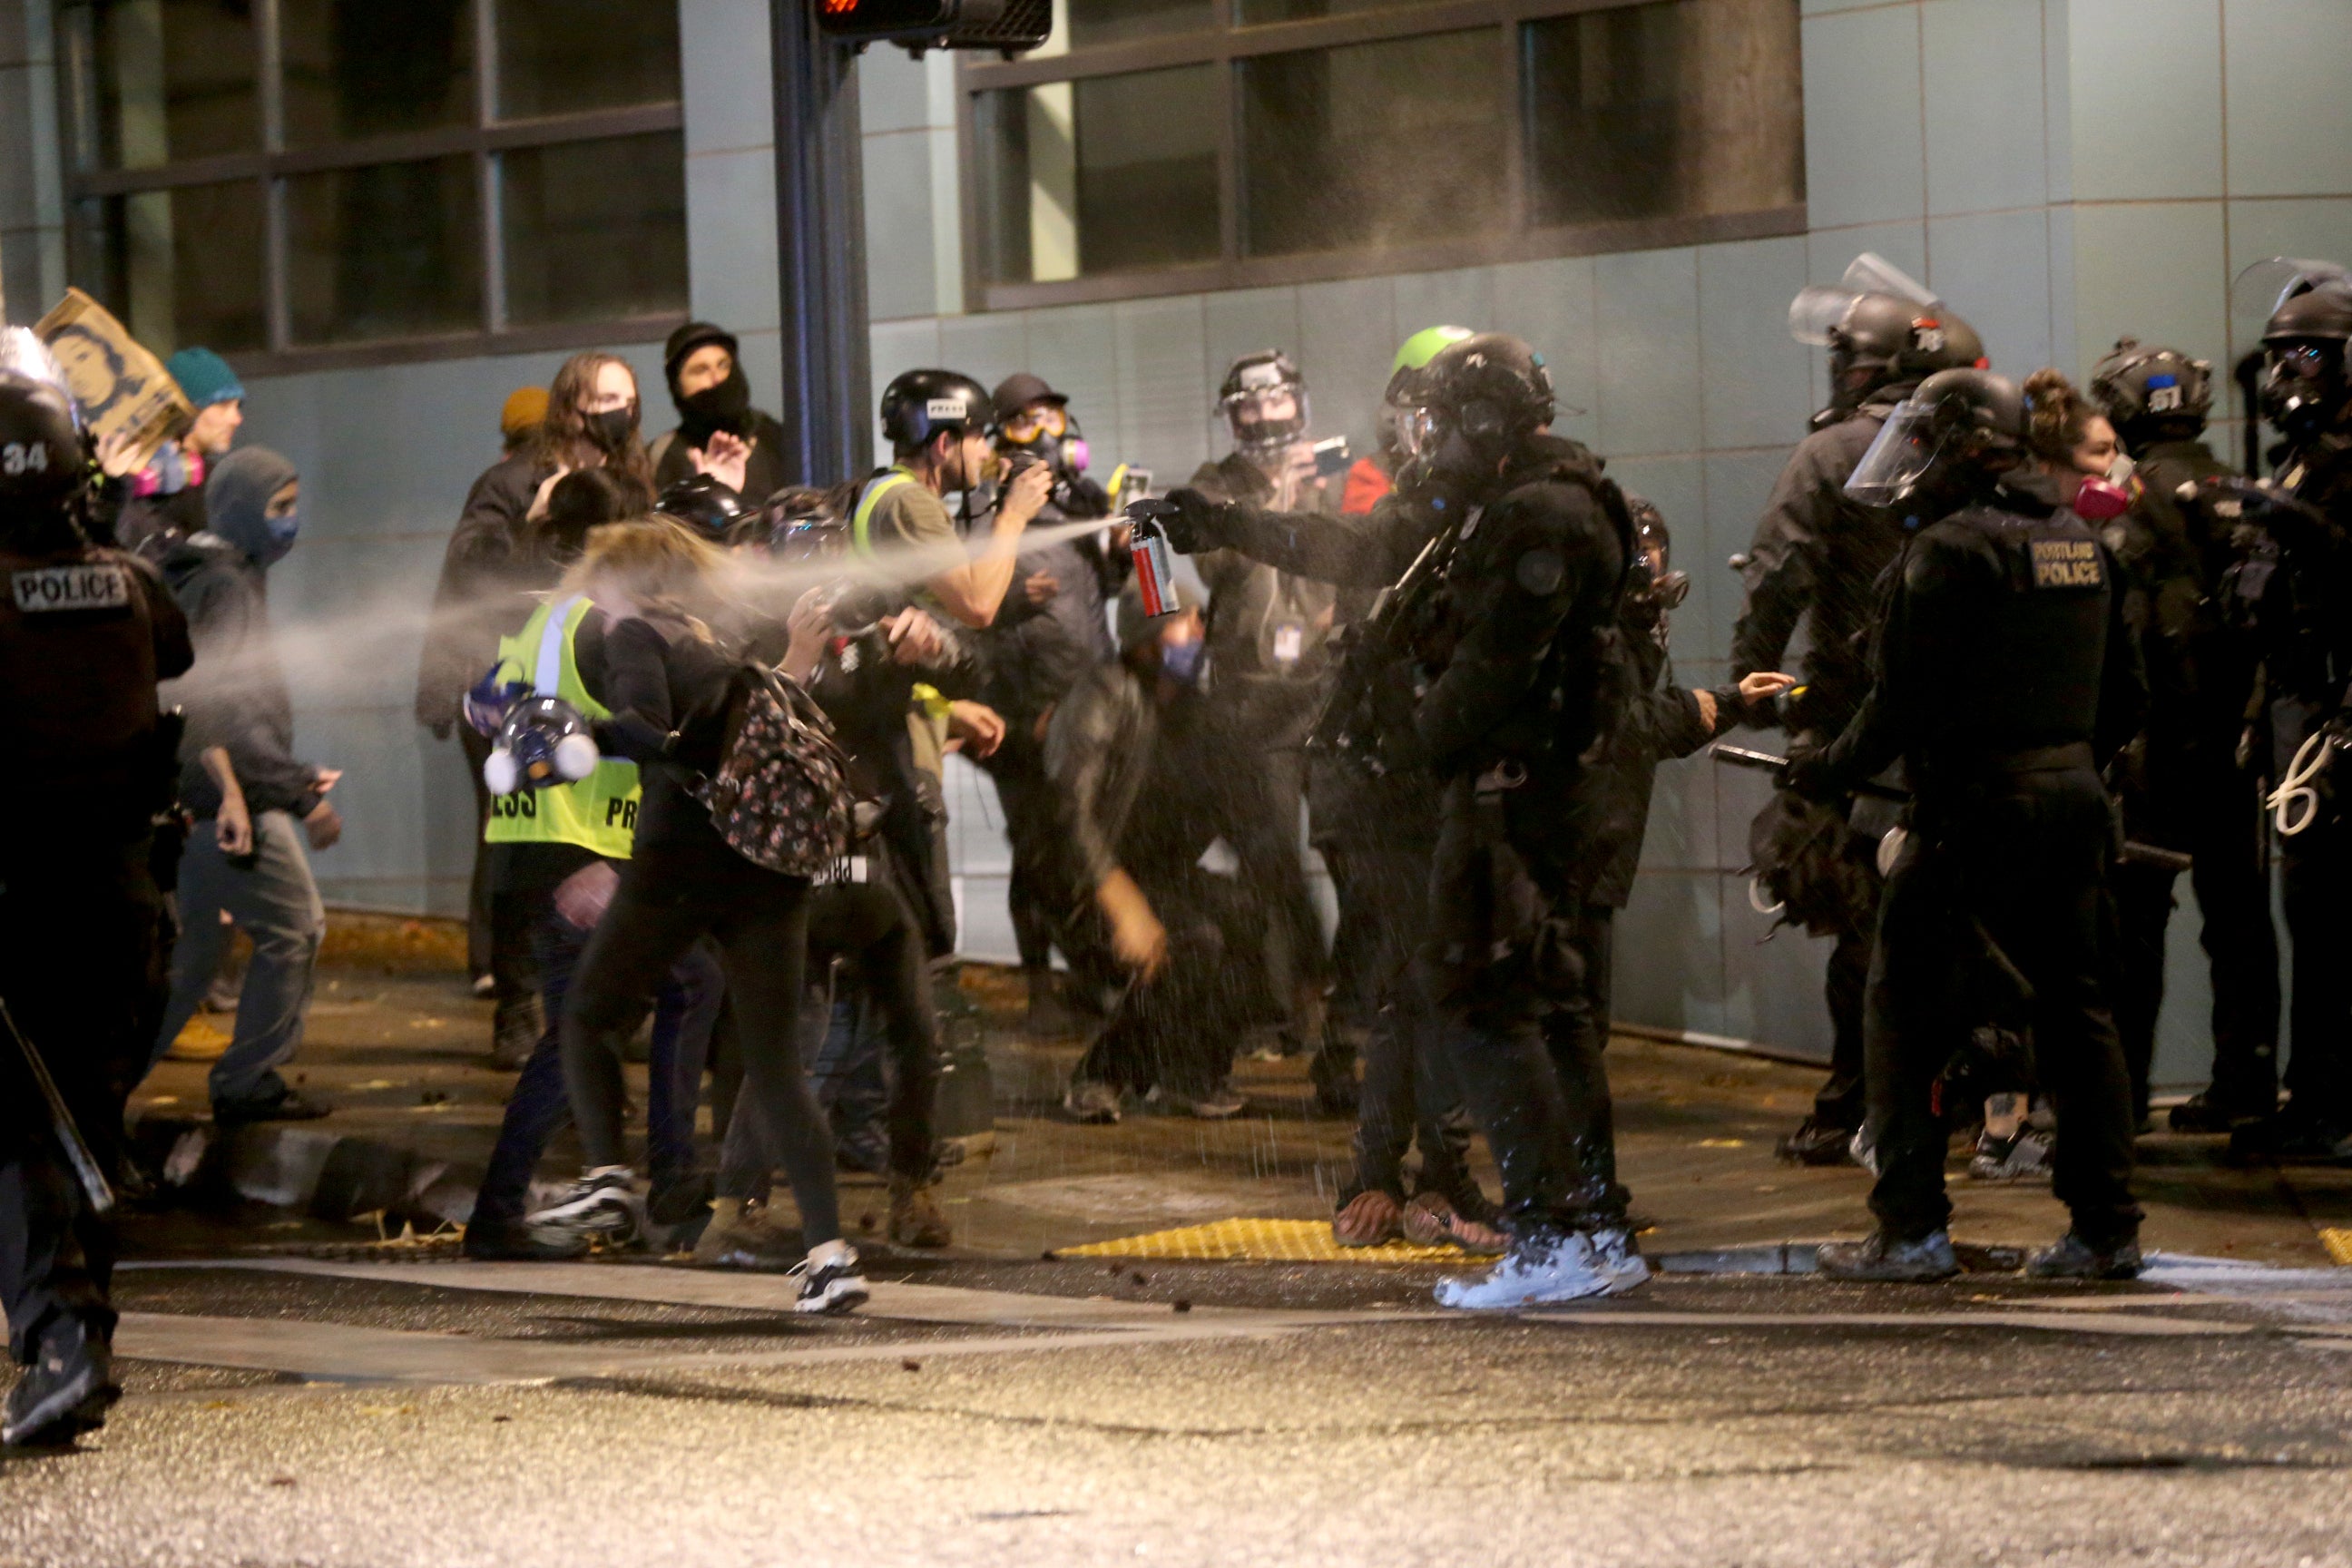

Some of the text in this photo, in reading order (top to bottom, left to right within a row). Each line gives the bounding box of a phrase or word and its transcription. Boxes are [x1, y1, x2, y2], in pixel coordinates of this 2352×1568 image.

[3, 440, 47, 475] 34
[2034, 541, 2094, 560] PORTLAND
[2037, 561, 2101, 585] POLICE
[20, 575, 121, 604] POLICE
